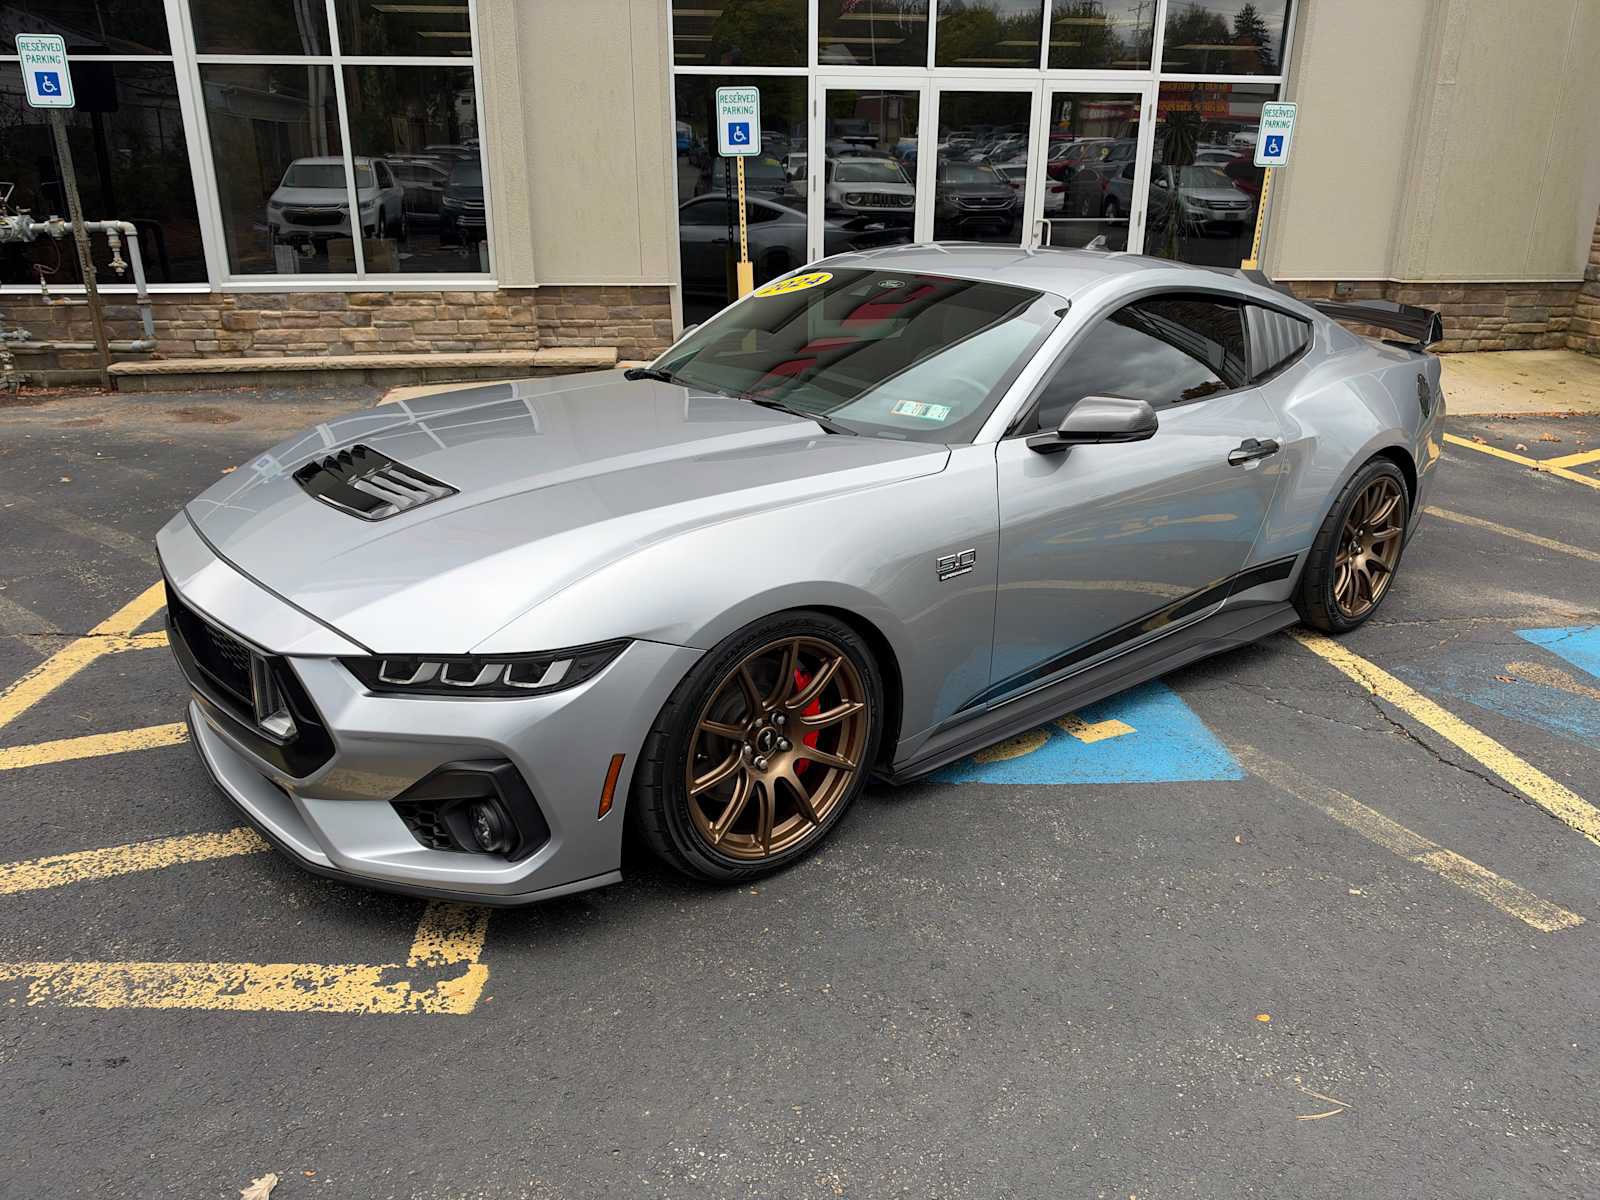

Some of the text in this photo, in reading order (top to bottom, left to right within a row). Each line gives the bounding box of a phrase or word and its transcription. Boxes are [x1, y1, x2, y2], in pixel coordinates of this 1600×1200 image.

[20, 42, 62, 51] RESERVED
[25, 54, 62, 64] PARKING
[719, 94, 756, 103] RESERVED
[722, 106, 754, 115] PARKING
[1264, 109, 1296, 118] RESERVED
[1264, 120, 1291, 128] PARKING
[936, 548, 976, 573] 5.0
